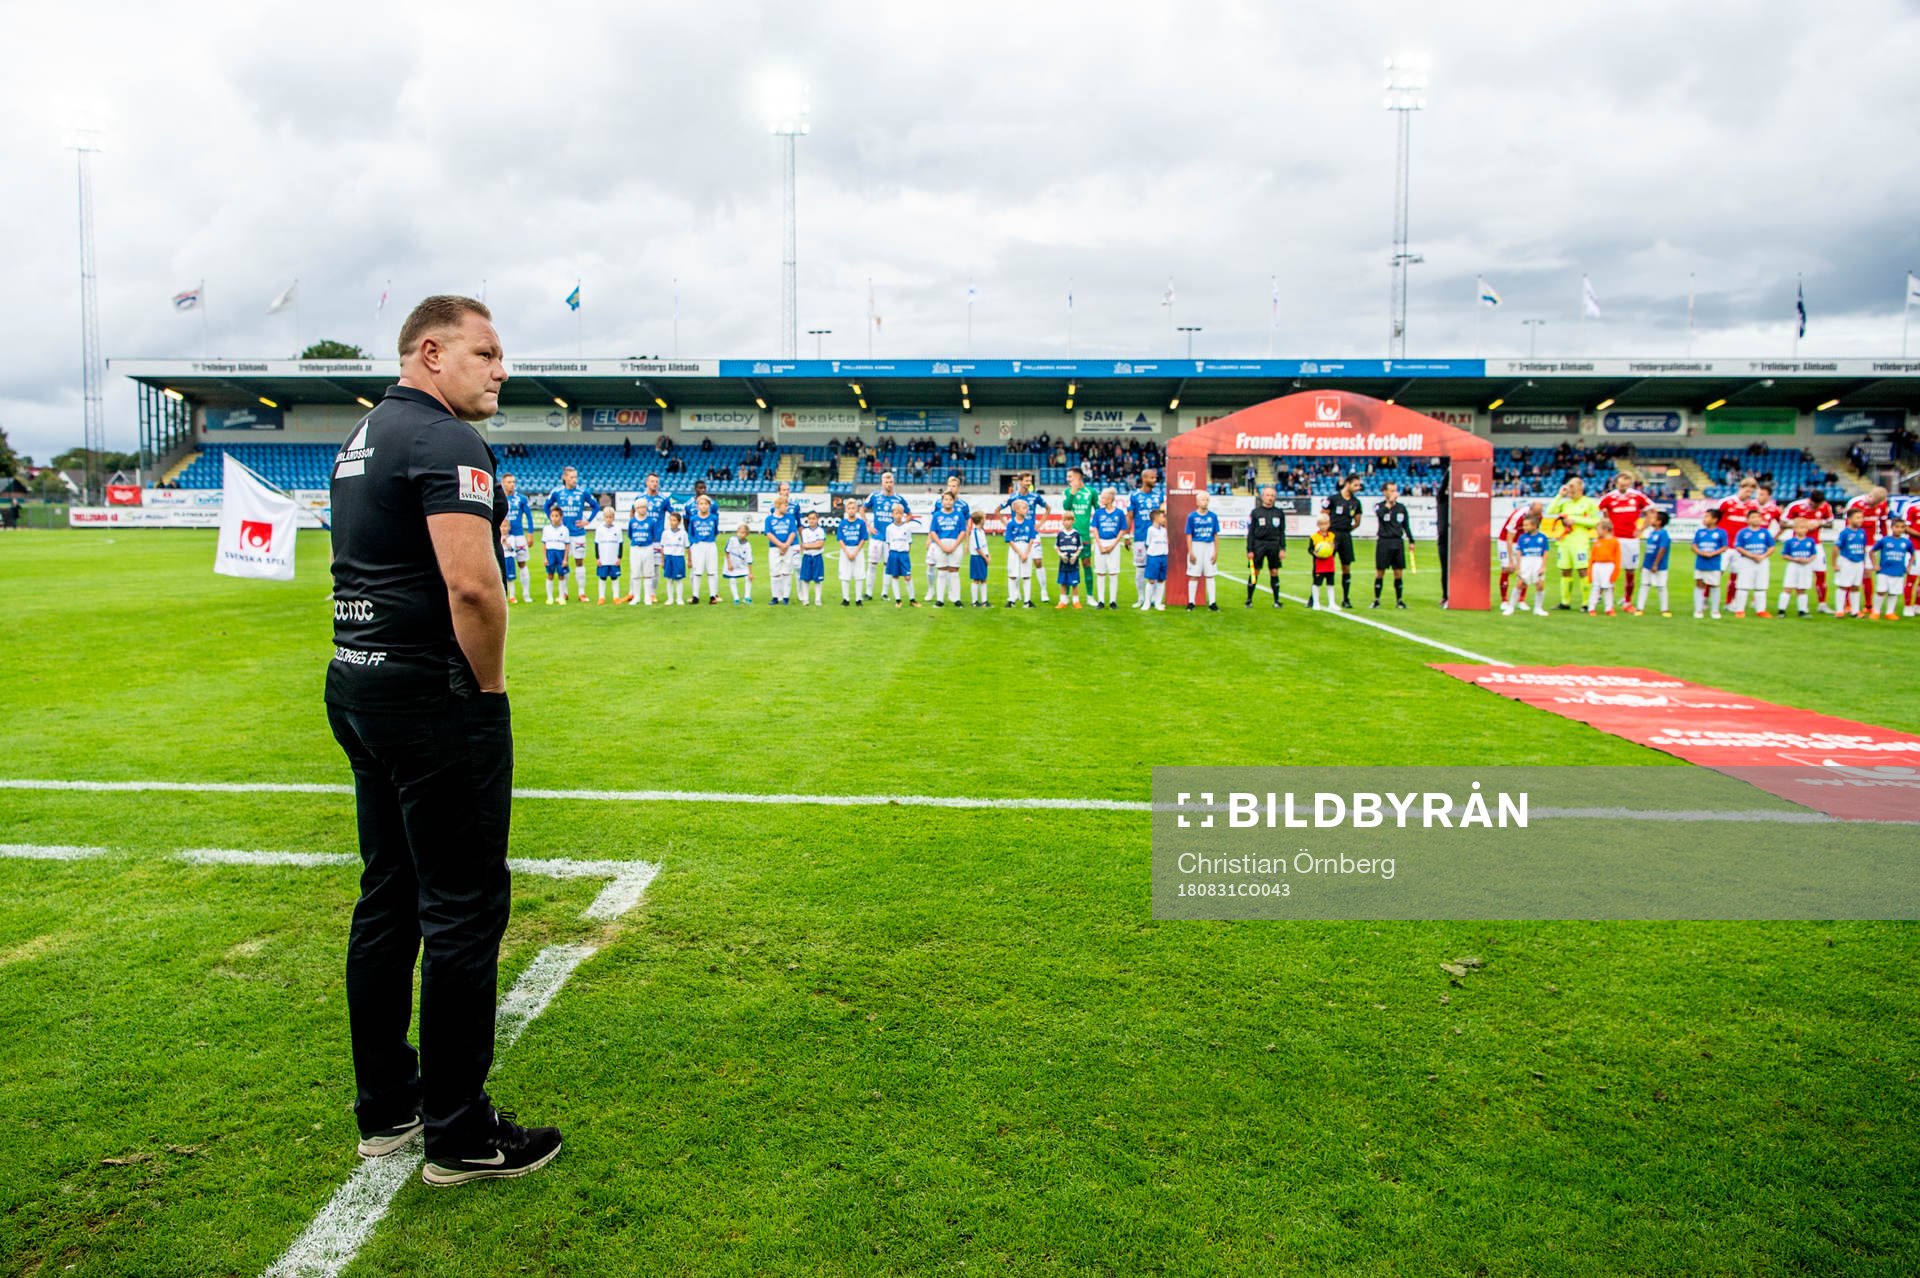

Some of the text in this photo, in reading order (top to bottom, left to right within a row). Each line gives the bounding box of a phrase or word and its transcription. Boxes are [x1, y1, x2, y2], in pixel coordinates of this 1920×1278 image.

[592, 409, 648, 426] ELON
[798, 412, 856, 424] exakta
[1083, 410, 1123, 422] SAWI
[1503, 414, 1568, 425] OPTIMERA
[1336, 421, 1353, 429] SPEL
[1235, 432, 1424, 451] Framåt för svensk fotboll!
[225, 551, 262, 564] SVENSKA
[367, 652, 387, 667] FF
